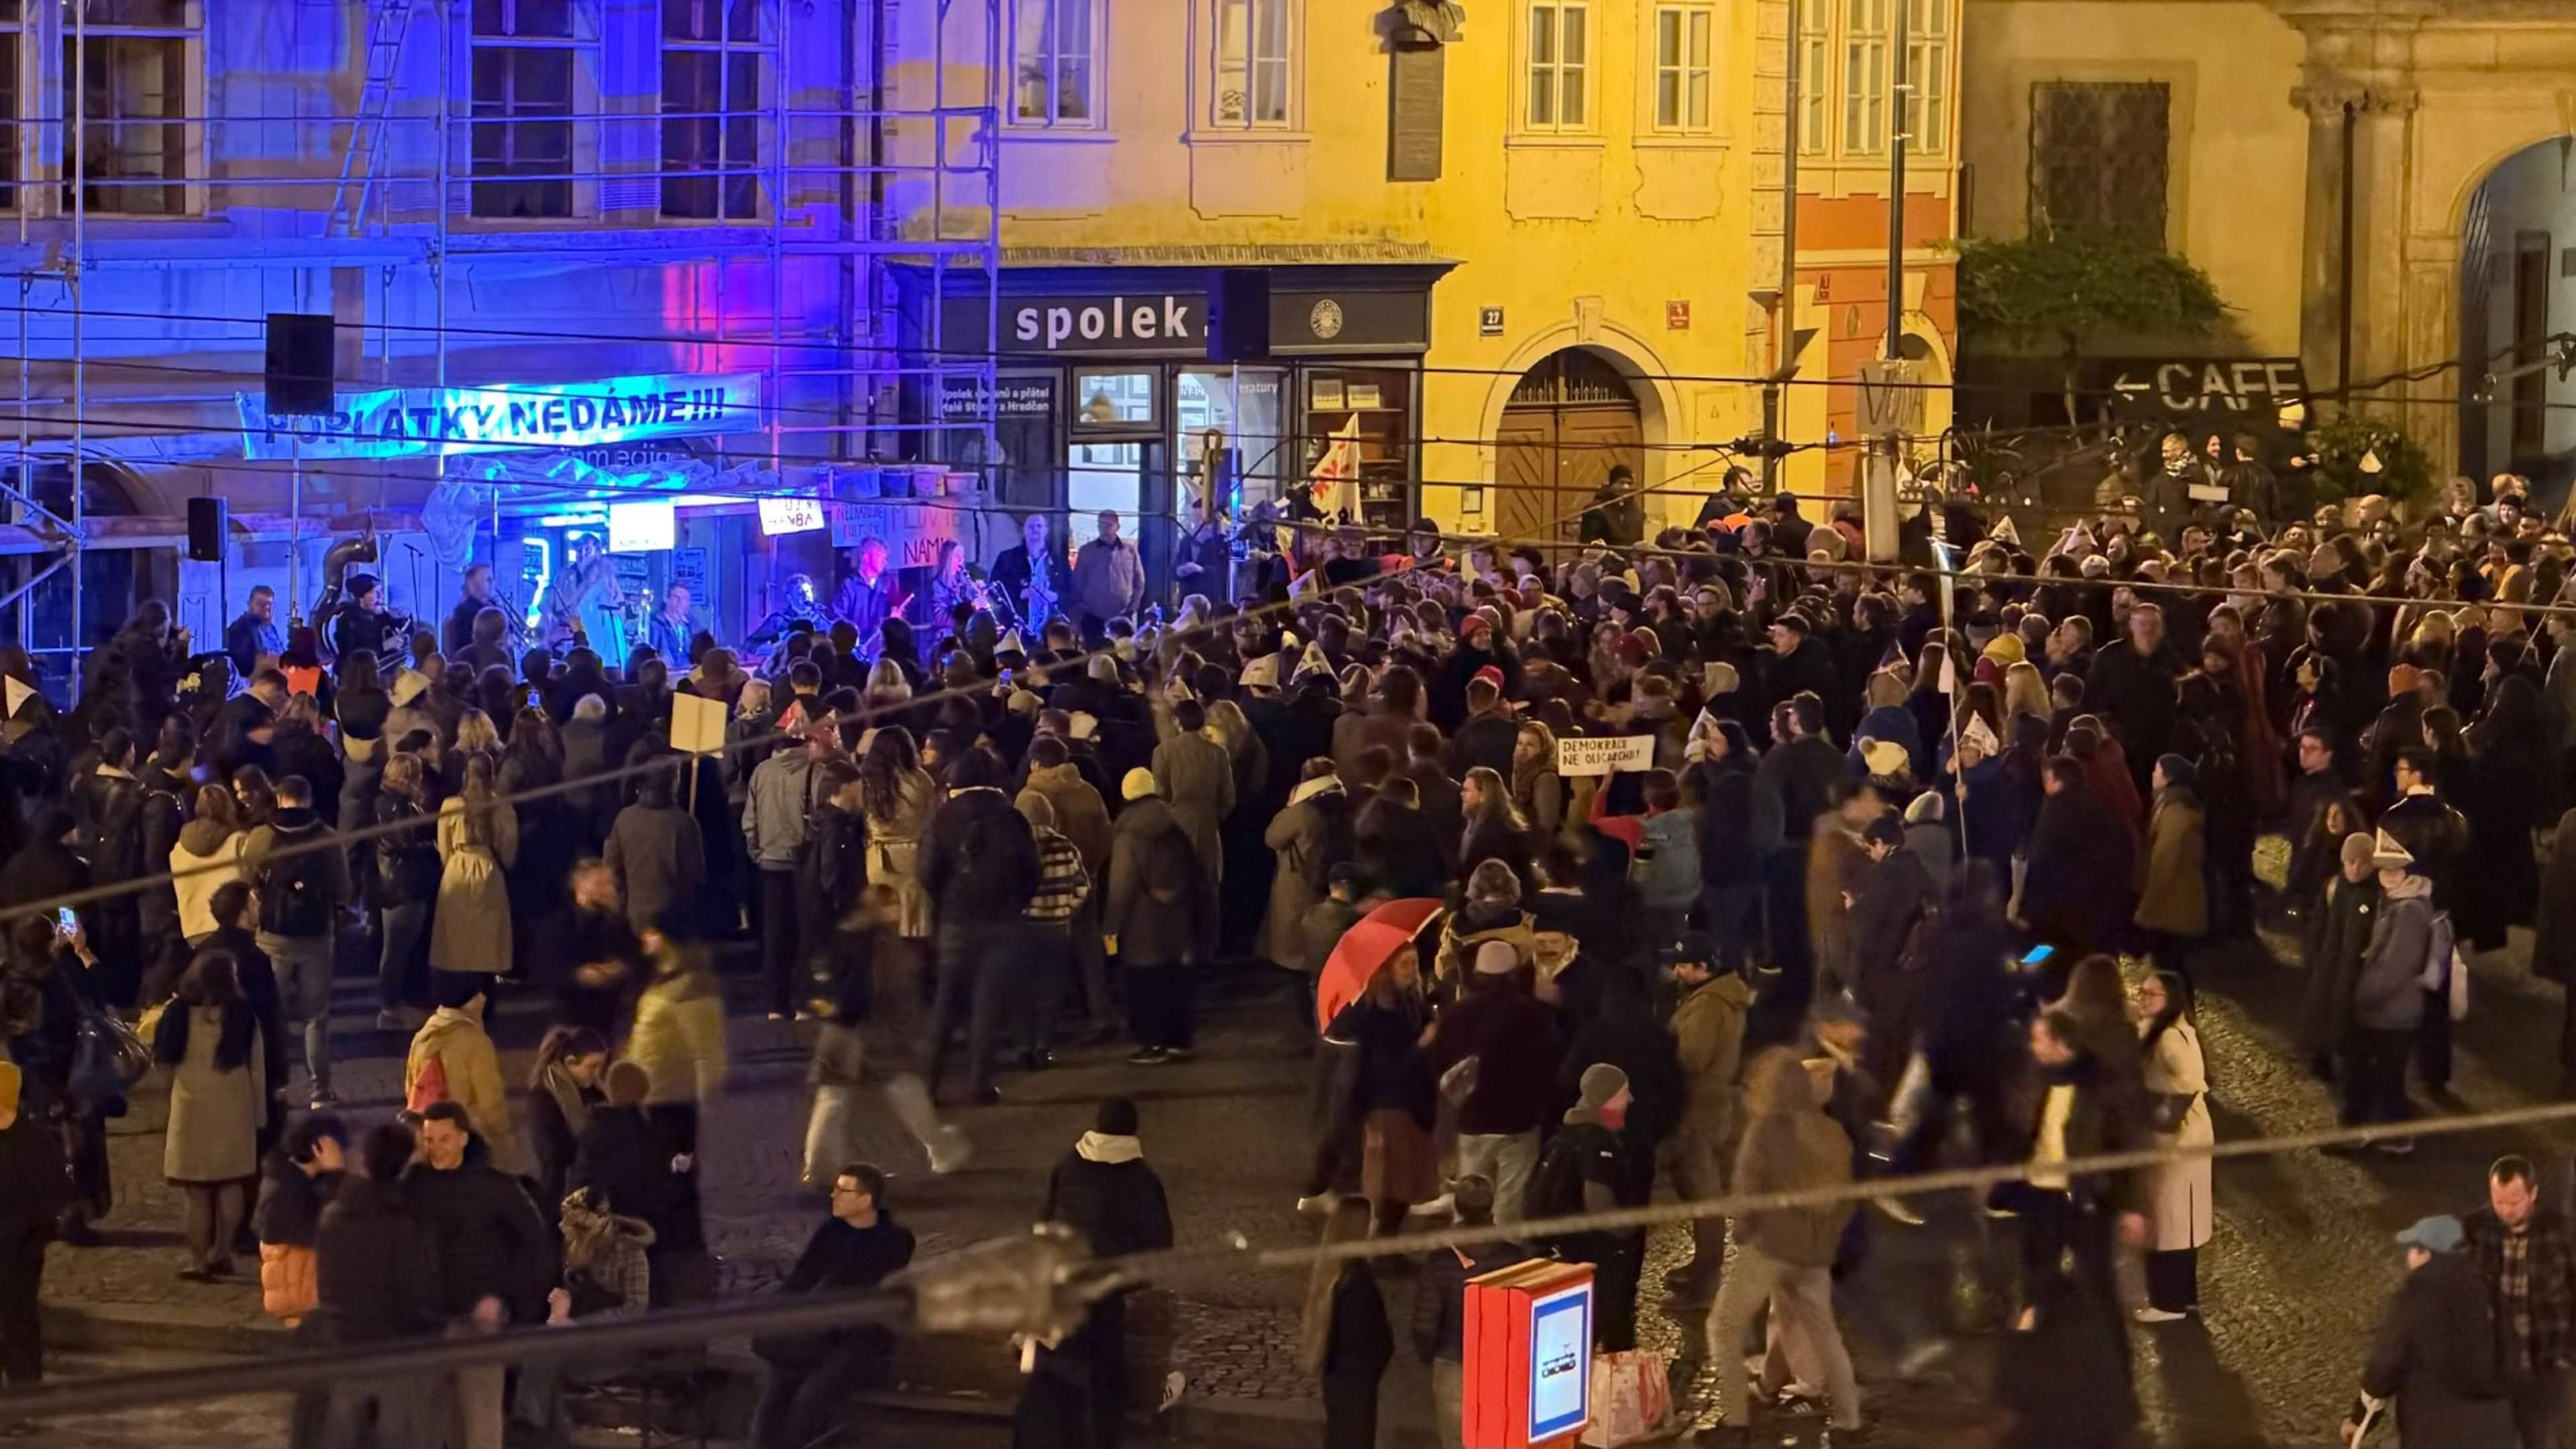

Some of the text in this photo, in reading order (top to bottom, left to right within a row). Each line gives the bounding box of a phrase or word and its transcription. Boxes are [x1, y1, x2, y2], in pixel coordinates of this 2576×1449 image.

[1016, 296, 1189, 349] spolek
[1487, 311, 1500, 324] 27
[264, 387, 725, 444] POPLATKY NEDÁME!!!
[1563, 753, 1578, 765] NE
